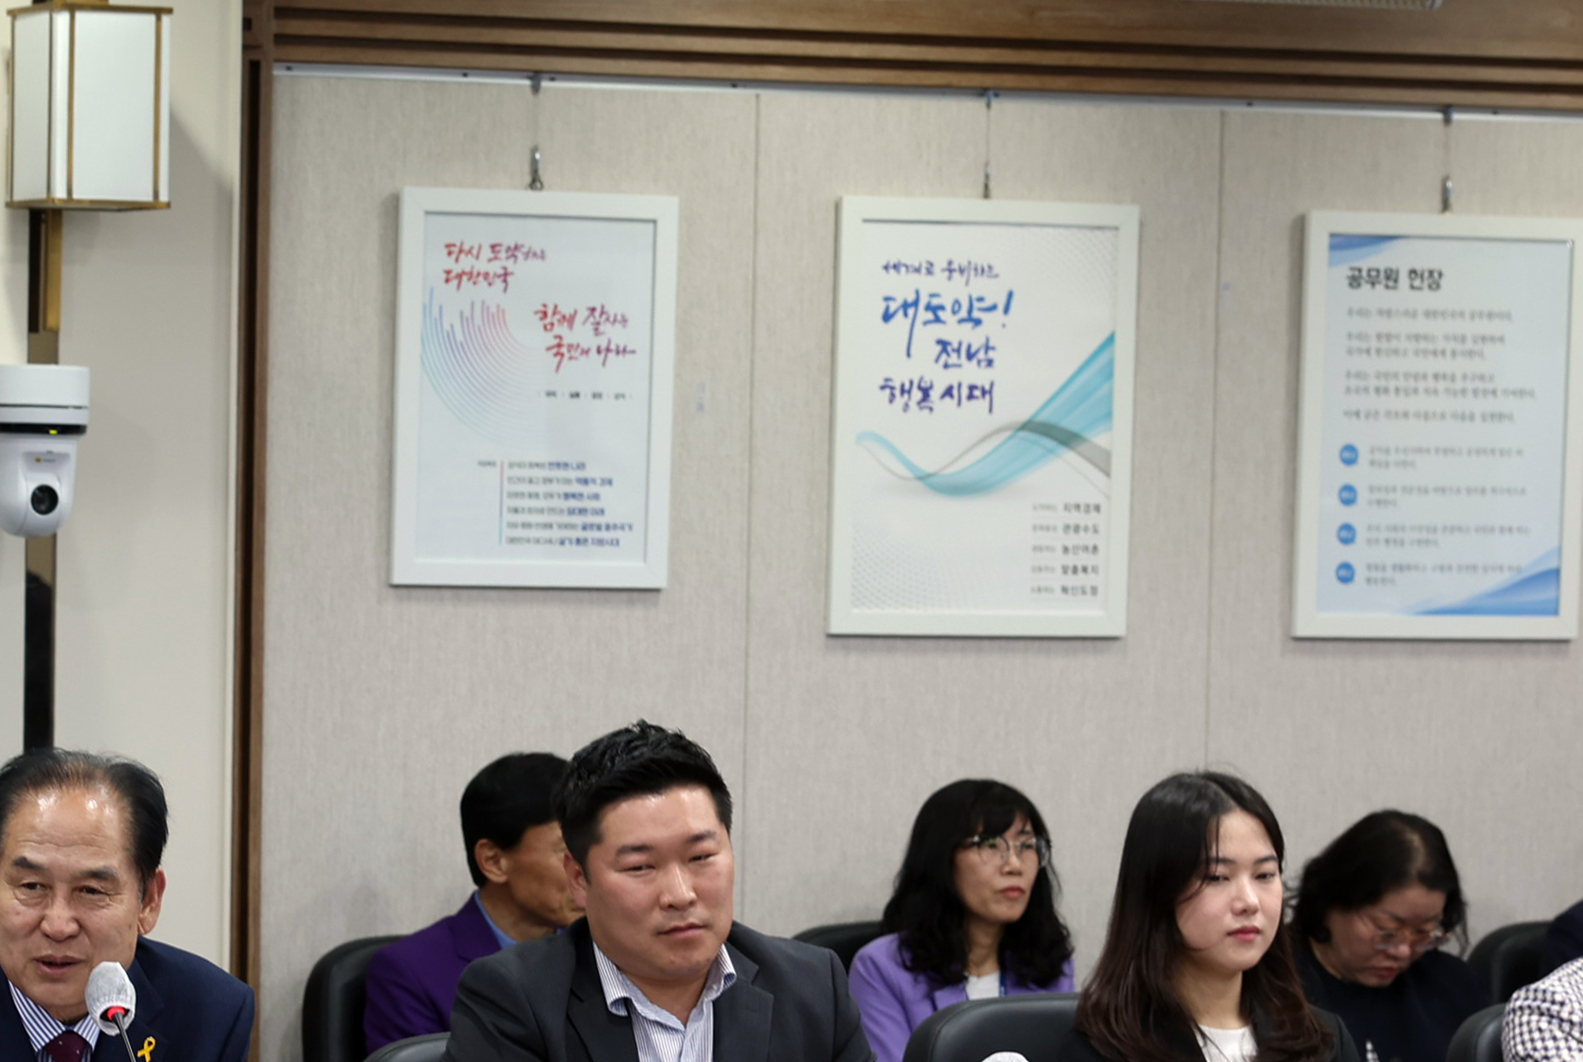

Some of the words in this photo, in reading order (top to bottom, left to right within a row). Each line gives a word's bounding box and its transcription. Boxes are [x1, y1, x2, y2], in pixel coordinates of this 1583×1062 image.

[444, 241, 482, 263] 다시
[443, 265, 514, 293] 대한민국
[1346, 266, 1400, 290] 공무원
[1407, 268, 1444, 291] 헌장
[534, 303, 577, 332] 함께
[881, 288, 1014, 359] 대도약!
[934, 335, 996, 369] 전남
